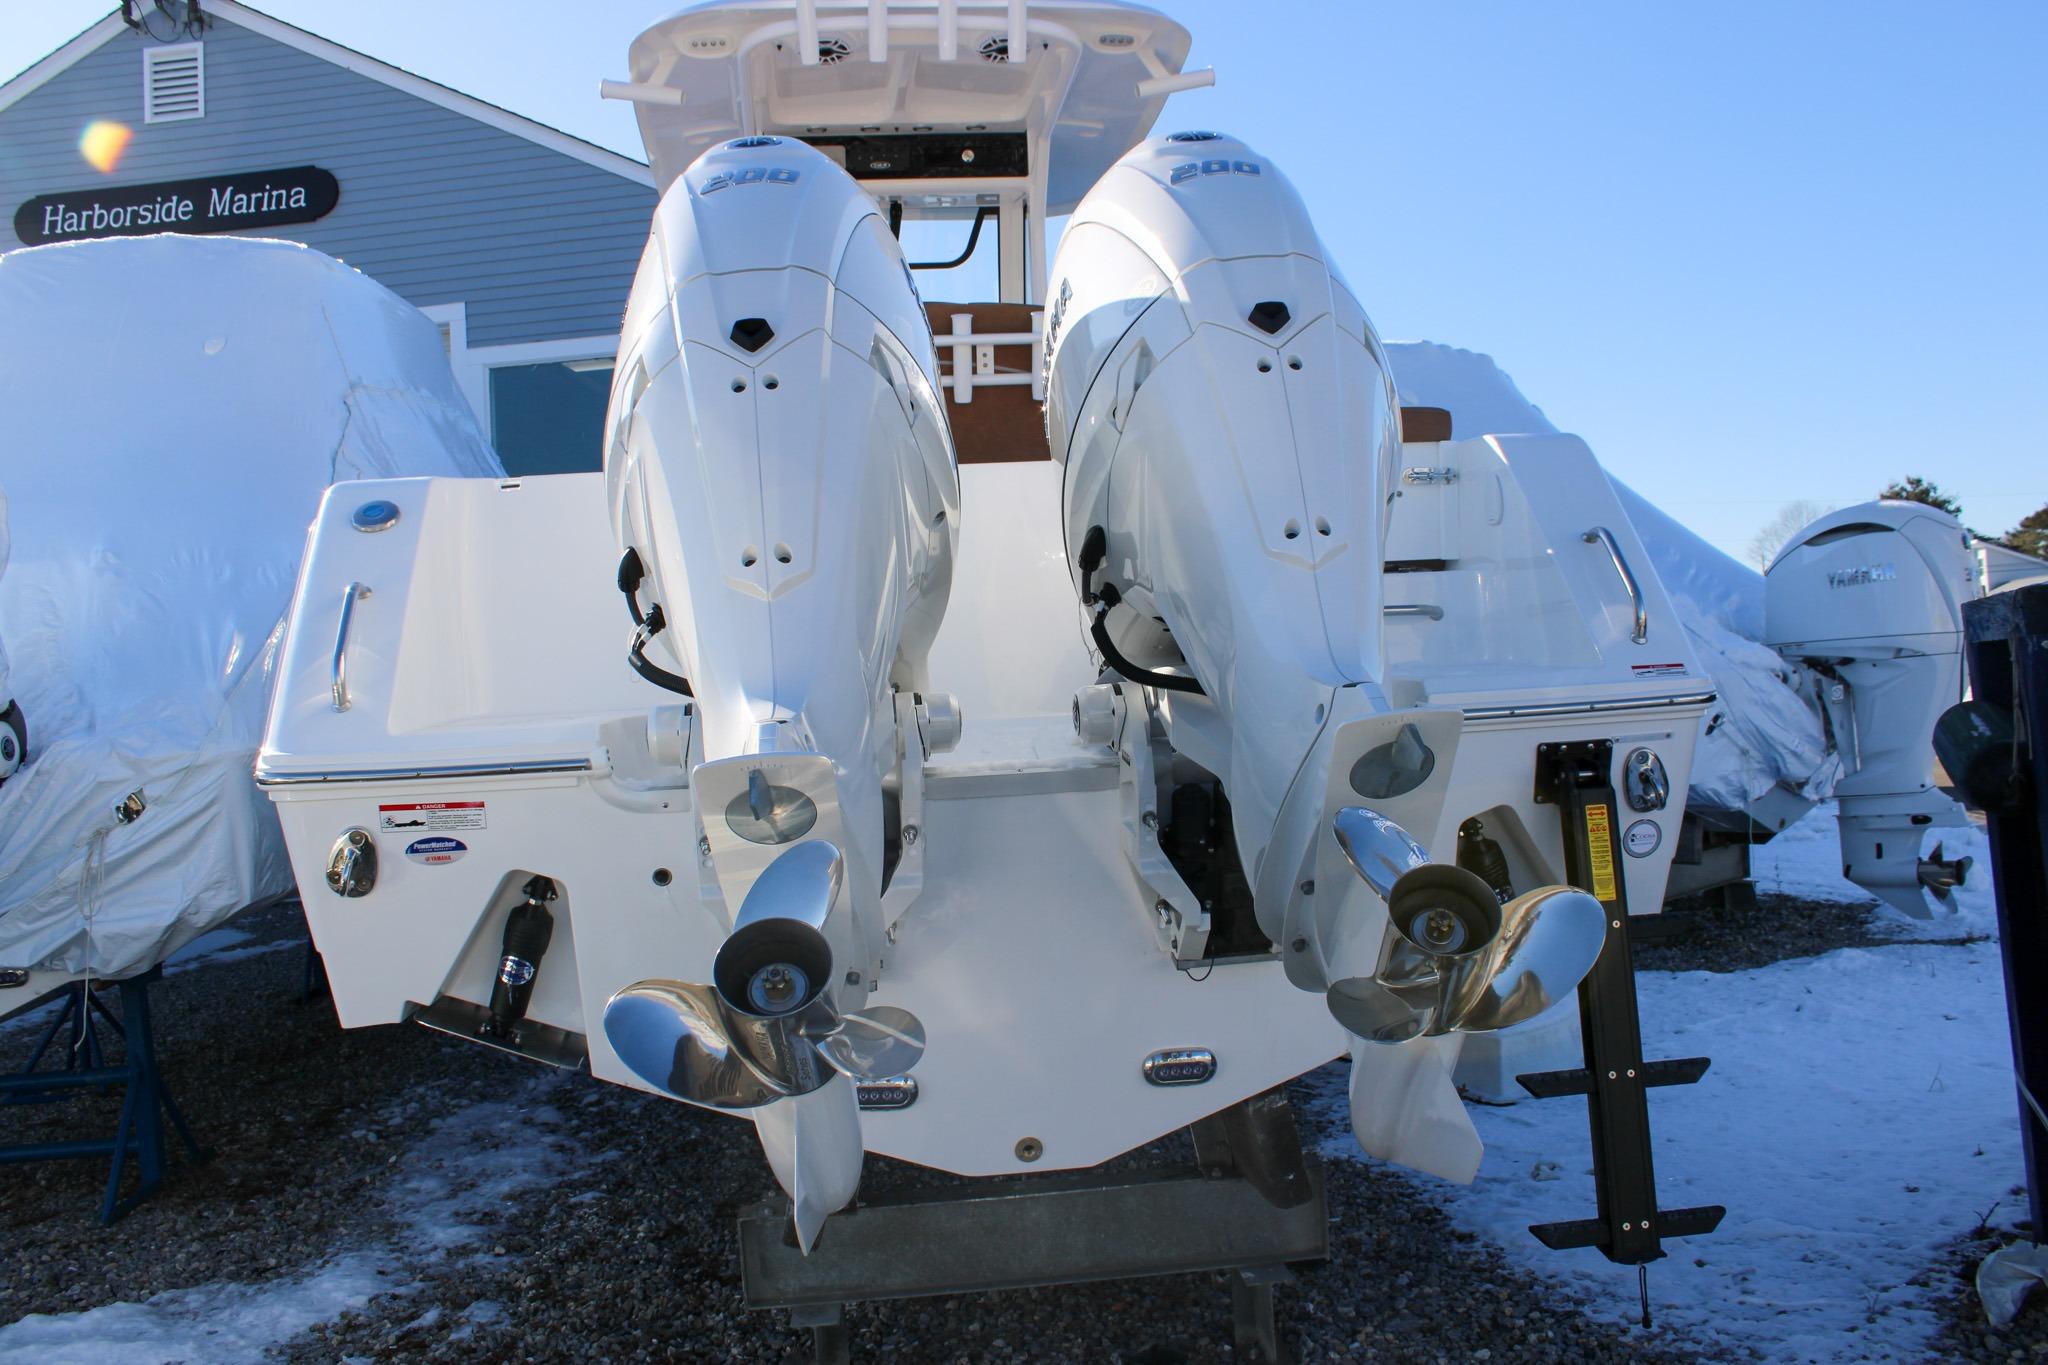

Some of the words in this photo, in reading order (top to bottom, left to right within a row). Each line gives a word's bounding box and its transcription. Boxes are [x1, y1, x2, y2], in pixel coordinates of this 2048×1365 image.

[700, 167, 801, 195] 200
[1169, 159, 1261, 185] 200
[42, 196, 194, 235] Harborside
[207, 184, 306, 217] Marina
[1826, 562, 1897, 589] YAMAHA
[413, 841, 456, 849] PowerMatched
